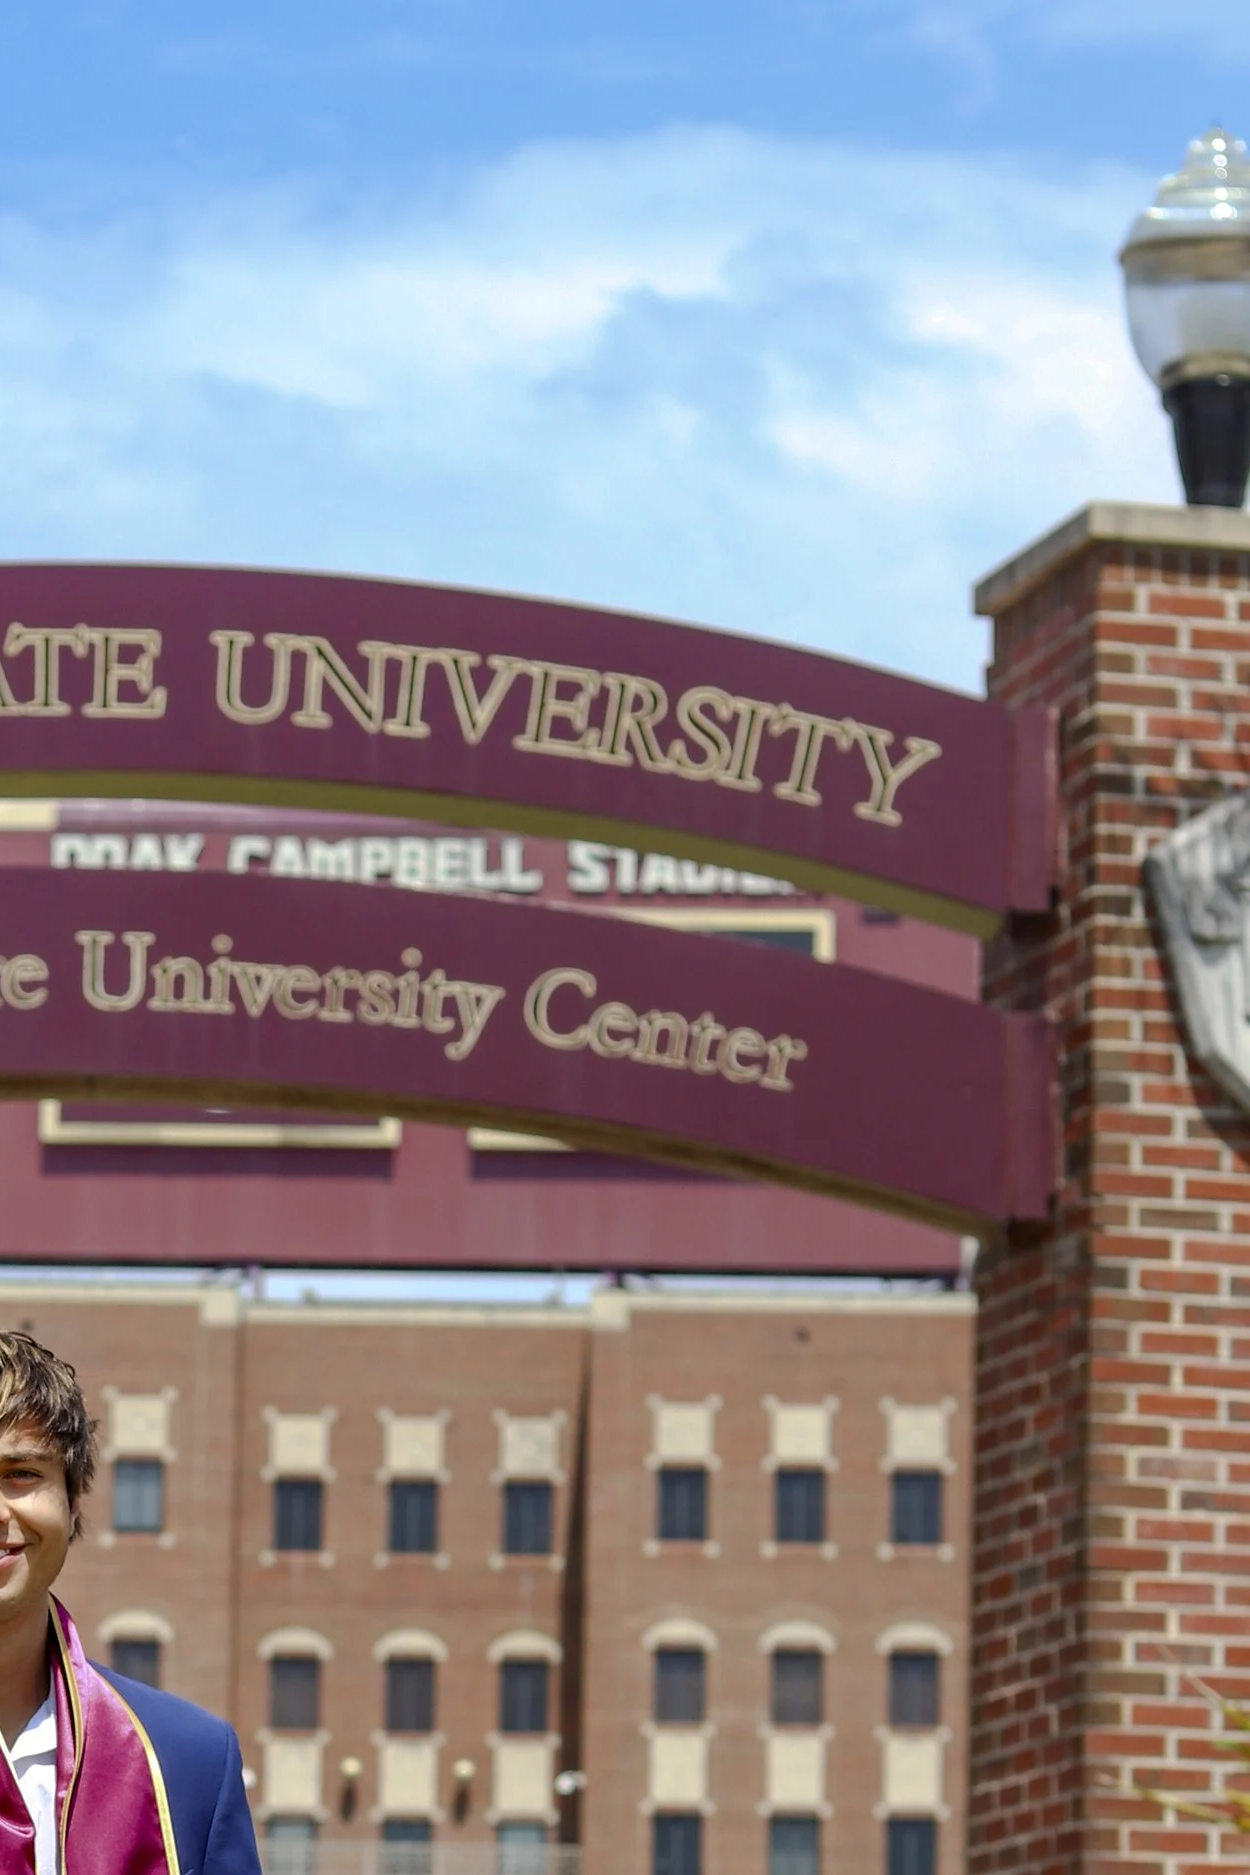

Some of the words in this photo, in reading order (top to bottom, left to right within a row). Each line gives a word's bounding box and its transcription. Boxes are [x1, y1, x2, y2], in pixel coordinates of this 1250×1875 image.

[209, 629, 942, 826] UNIVERSITY
[226, 834, 543, 893] CAMPBELL
[567, 839, 805, 896] STAD
[76, 930, 506, 1060] University
[523, 967, 808, 1090] Center
